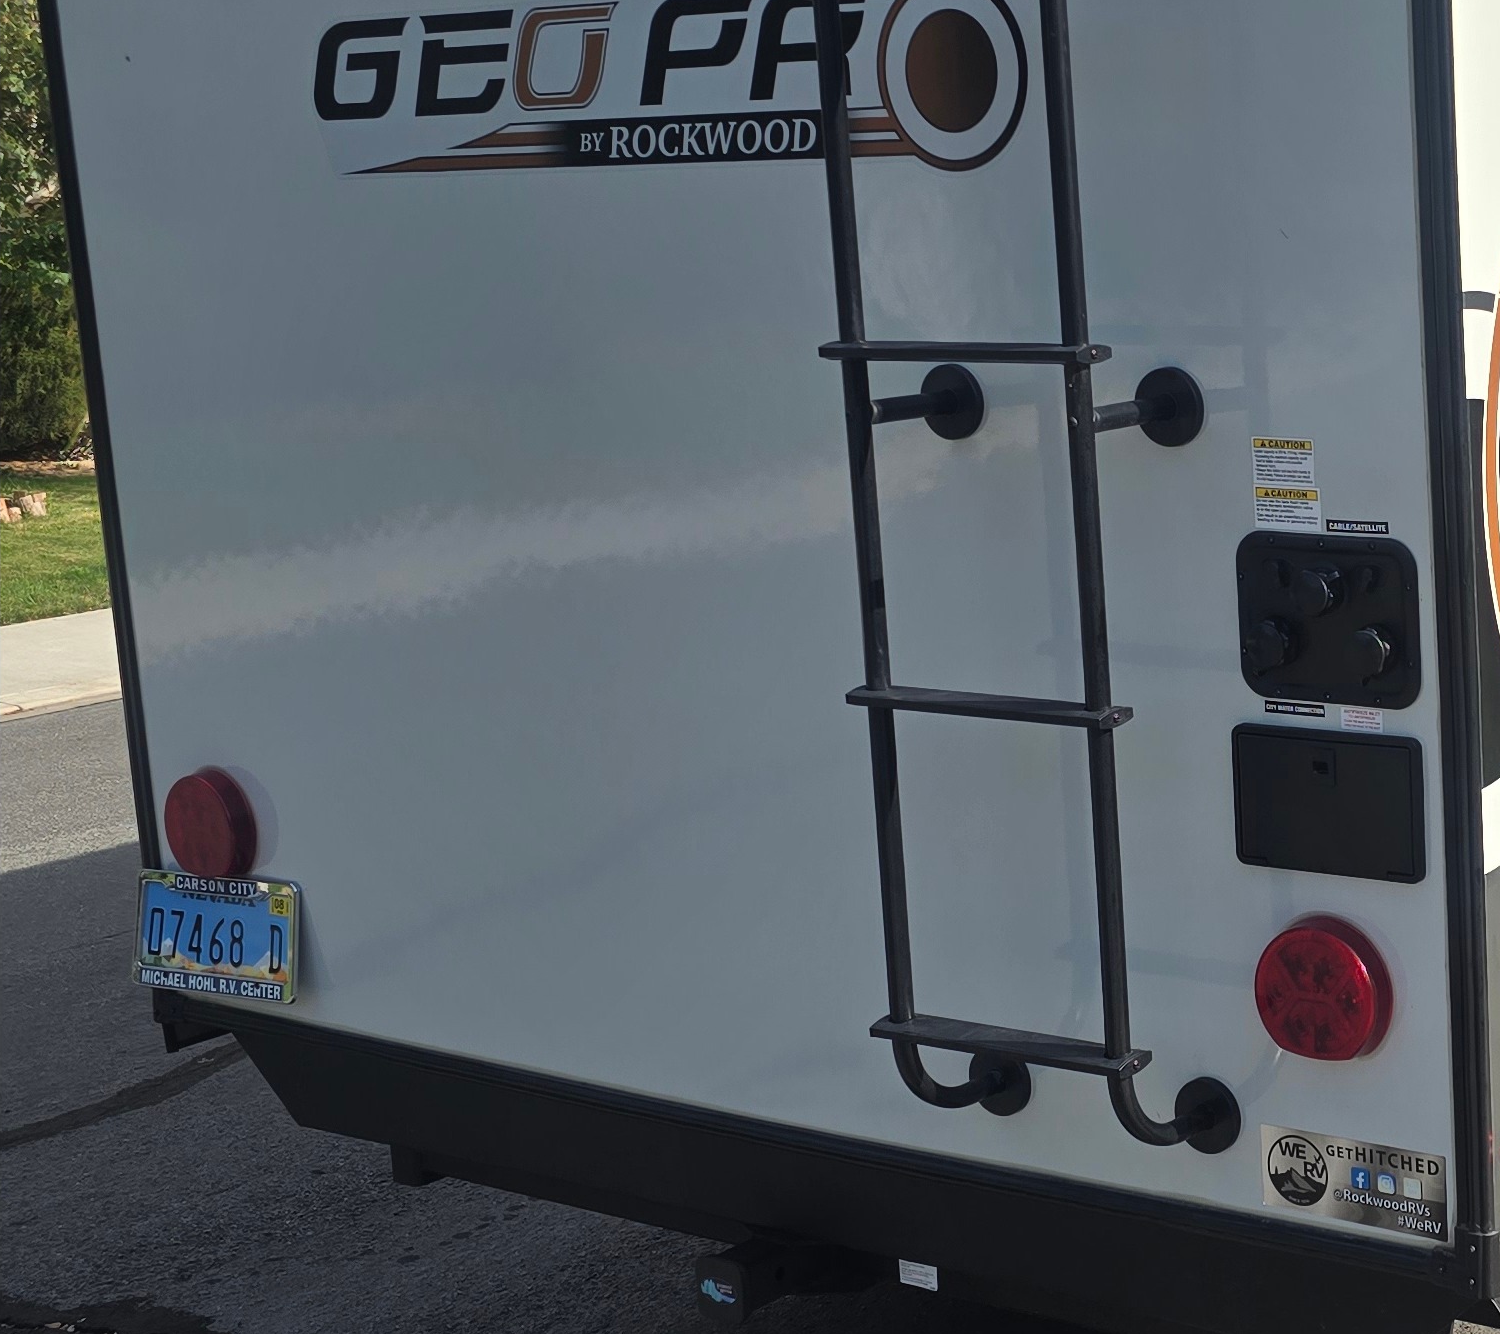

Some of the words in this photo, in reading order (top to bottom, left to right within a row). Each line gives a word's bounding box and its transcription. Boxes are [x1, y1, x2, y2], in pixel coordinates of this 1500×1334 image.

[313, 1, 619, 121] GEO
[580, 132, 605, 152] BY
[609, 118, 817, 159] ROCKWOOD
[1268, 440, 1306, 449] CAUTION
[1270, 490, 1308, 499] CAUTION
[176, 876, 225, 893] CARSON
[229, 882, 256, 896] CITY
[147, 907, 244, 968] 07468
[268, 924, 283, 974] D
[141, 969, 186, 988] MICHAEL
[188, 975, 217, 992] HOHL
[219, 978, 238, 995] R.V.
[240, 981, 281, 1000] CENTER
[1279, 1141, 1306, 1160] WE
[1304, 1161, 1325, 1179] RV
[1334, 1188, 1431, 1217] @RockwoodRVs
[1397, 1214, 1442, 1235] #WeRV
